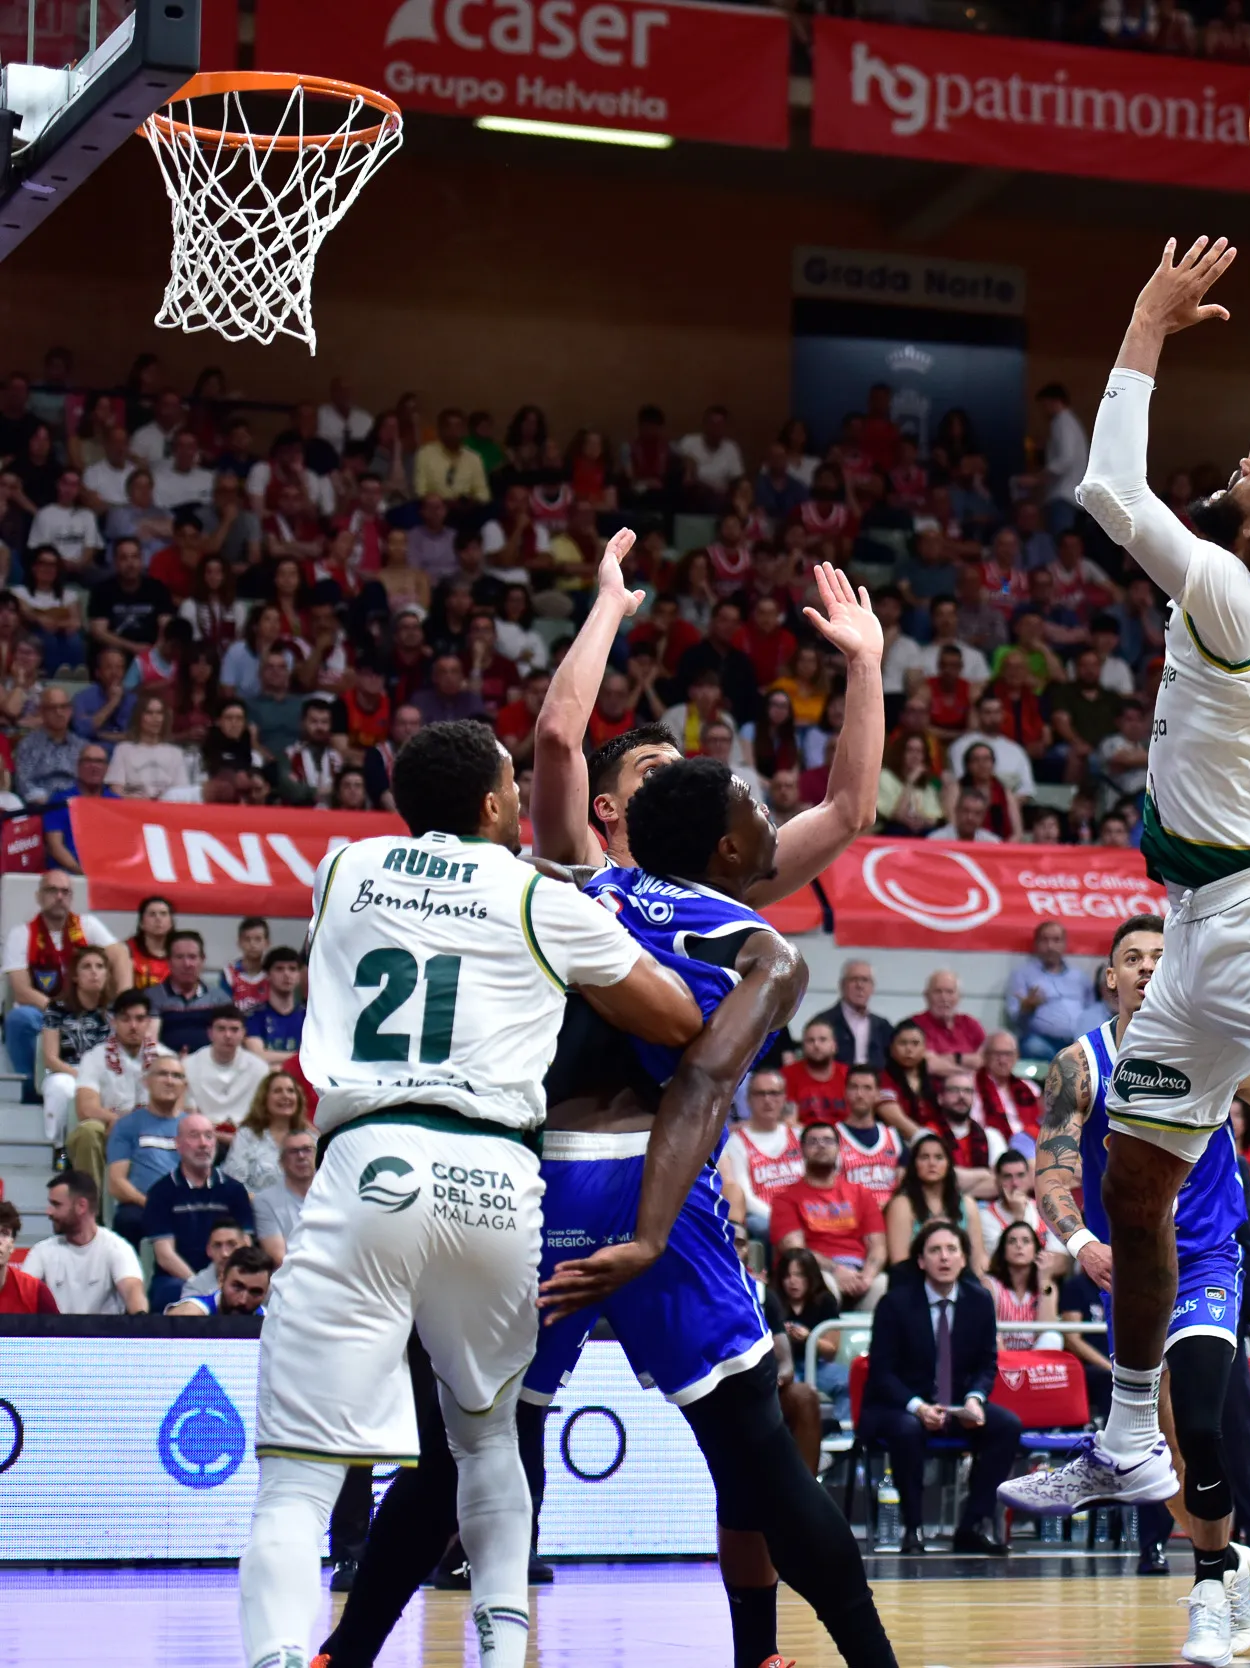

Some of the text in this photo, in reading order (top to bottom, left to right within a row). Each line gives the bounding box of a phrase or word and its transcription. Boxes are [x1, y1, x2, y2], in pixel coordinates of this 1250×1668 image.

[444, 0, 670, 68] caser
[384, 60, 669, 119] Grupo Helvetia
[803, 255, 1016, 304] Grada Norte
[383, 847, 479, 884] RUBIT
[1018, 870, 1149, 892] Costa Cálida
[351, 947, 462, 1065] 21
[431, 1161, 515, 1192] COSTA
[433, 1183, 518, 1212] DEL SOL
[433, 1202, 517, 1231] MÁLAGA
